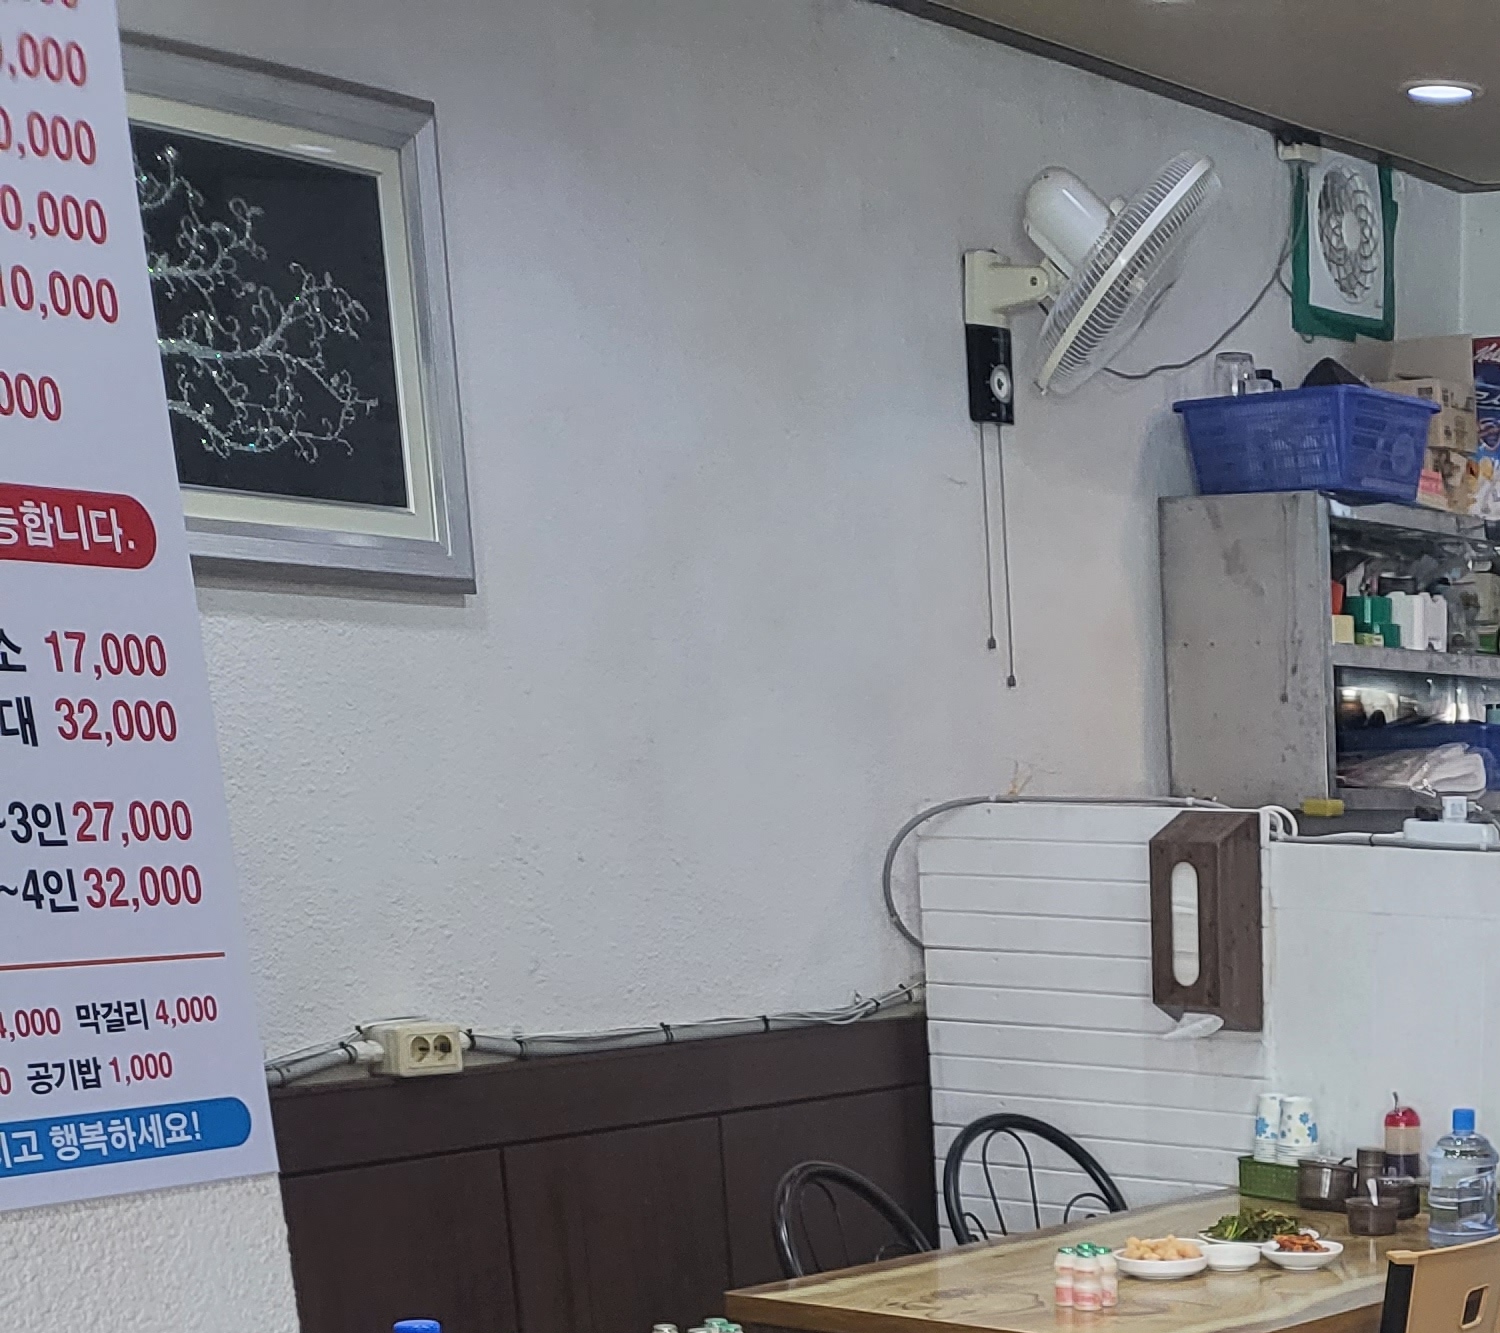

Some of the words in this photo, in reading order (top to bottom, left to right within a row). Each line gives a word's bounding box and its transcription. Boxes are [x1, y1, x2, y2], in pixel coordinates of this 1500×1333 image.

[0, 32, 87, 87] ,000
[44, 630, 167, 680] 17,000
[0, 696, 38, 747] 대
[55, 698, 176, 747] 32,000
[72, 801, 192, 848] 27,000
[83, 865, 201, 913] 32,000
[76, 998, 149, 1034] 막걸리
[155, 996, 217, 1029] 4,000
[27, 1057, 101, 1095] 공기밥
[108, 1052, 172, 1086] 1,000
[49, 1111, 202, 1162] 행복하세요!
